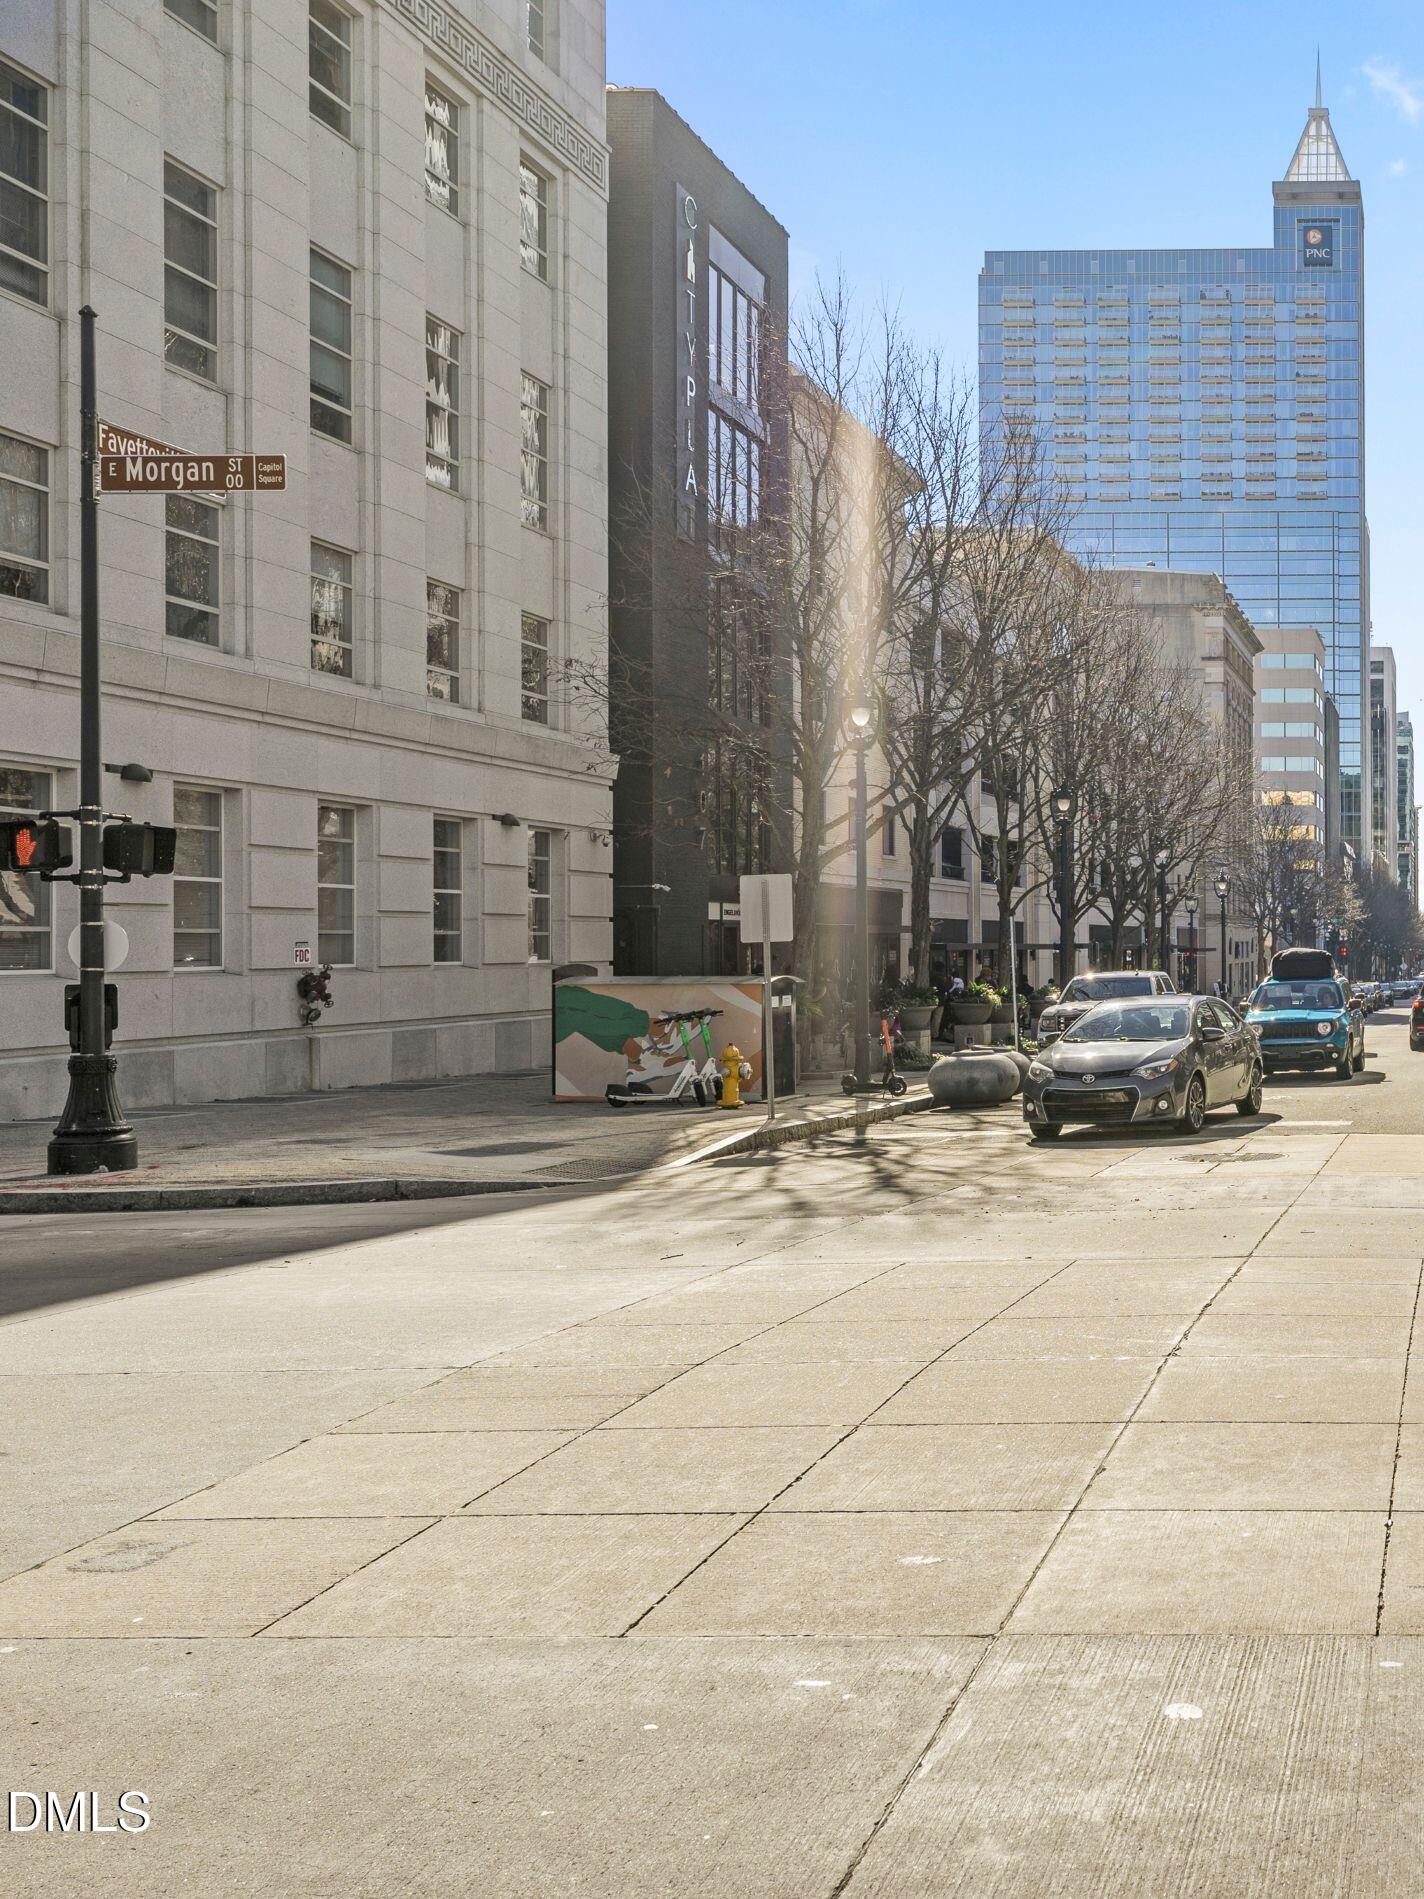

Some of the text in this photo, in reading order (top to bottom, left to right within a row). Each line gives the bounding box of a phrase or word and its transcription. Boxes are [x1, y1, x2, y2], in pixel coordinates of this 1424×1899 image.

[1305, 248, 1330, 258] PNC
[98, 423, 181, 455] Fayette
[109, 457, 243, 489] E Morgan ST
[258, 462, 282, 472] Capitol
[226, 474, 243, 488] 00
[258, 474, 282, 484] Square
[295, 949, 310, 963] FDC
